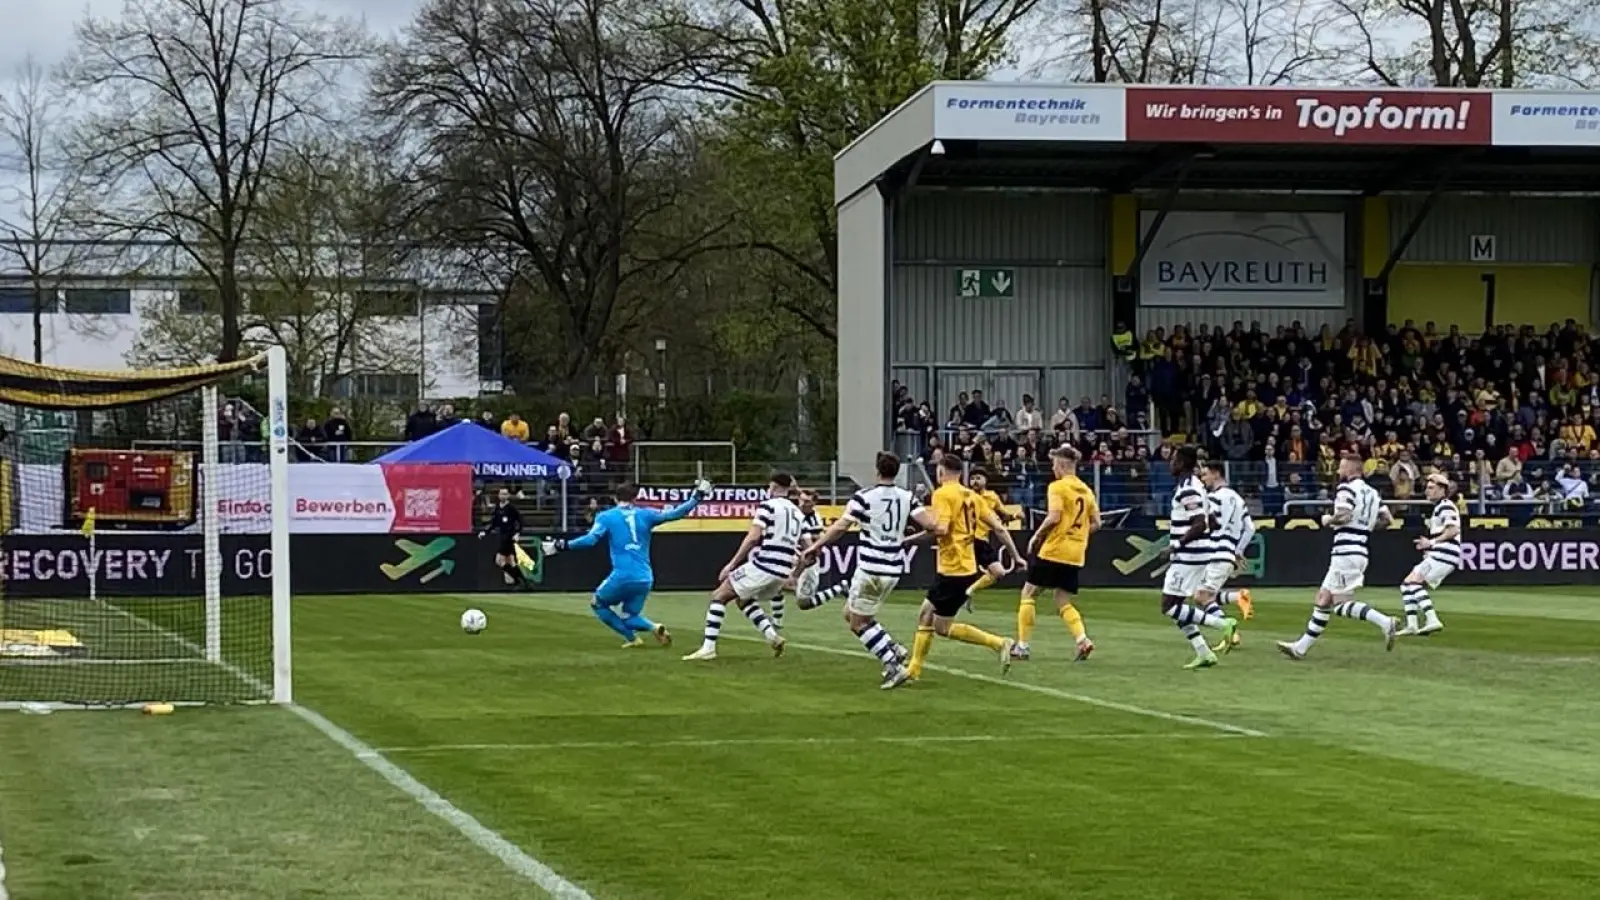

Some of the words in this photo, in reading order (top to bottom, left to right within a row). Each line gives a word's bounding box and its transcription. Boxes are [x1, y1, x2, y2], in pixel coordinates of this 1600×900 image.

[946, 97, 1086, 111] Formentechnik
[1145, 103, 1177, 119] Wir
[1265, 104, 1283, 120] in
[1296, 97, 1471, 136] Topform!
[1510, 104, 1600, 117] Formente
[1014, 112, 1100, 125] Bayreuth
[1474, 237, 1493, 259] M
[218, 498, 272, 514] Einfac
[636, 486, 771, 501] ALTSTDTFRON
[783, 506, 800, 537] 15
[879, 498, 901, 532] 31
[1071, 496, 1085, 529] 2
[624, 513, 638, 543] 1
[1458, 541, 1600, 570] RECOVER
